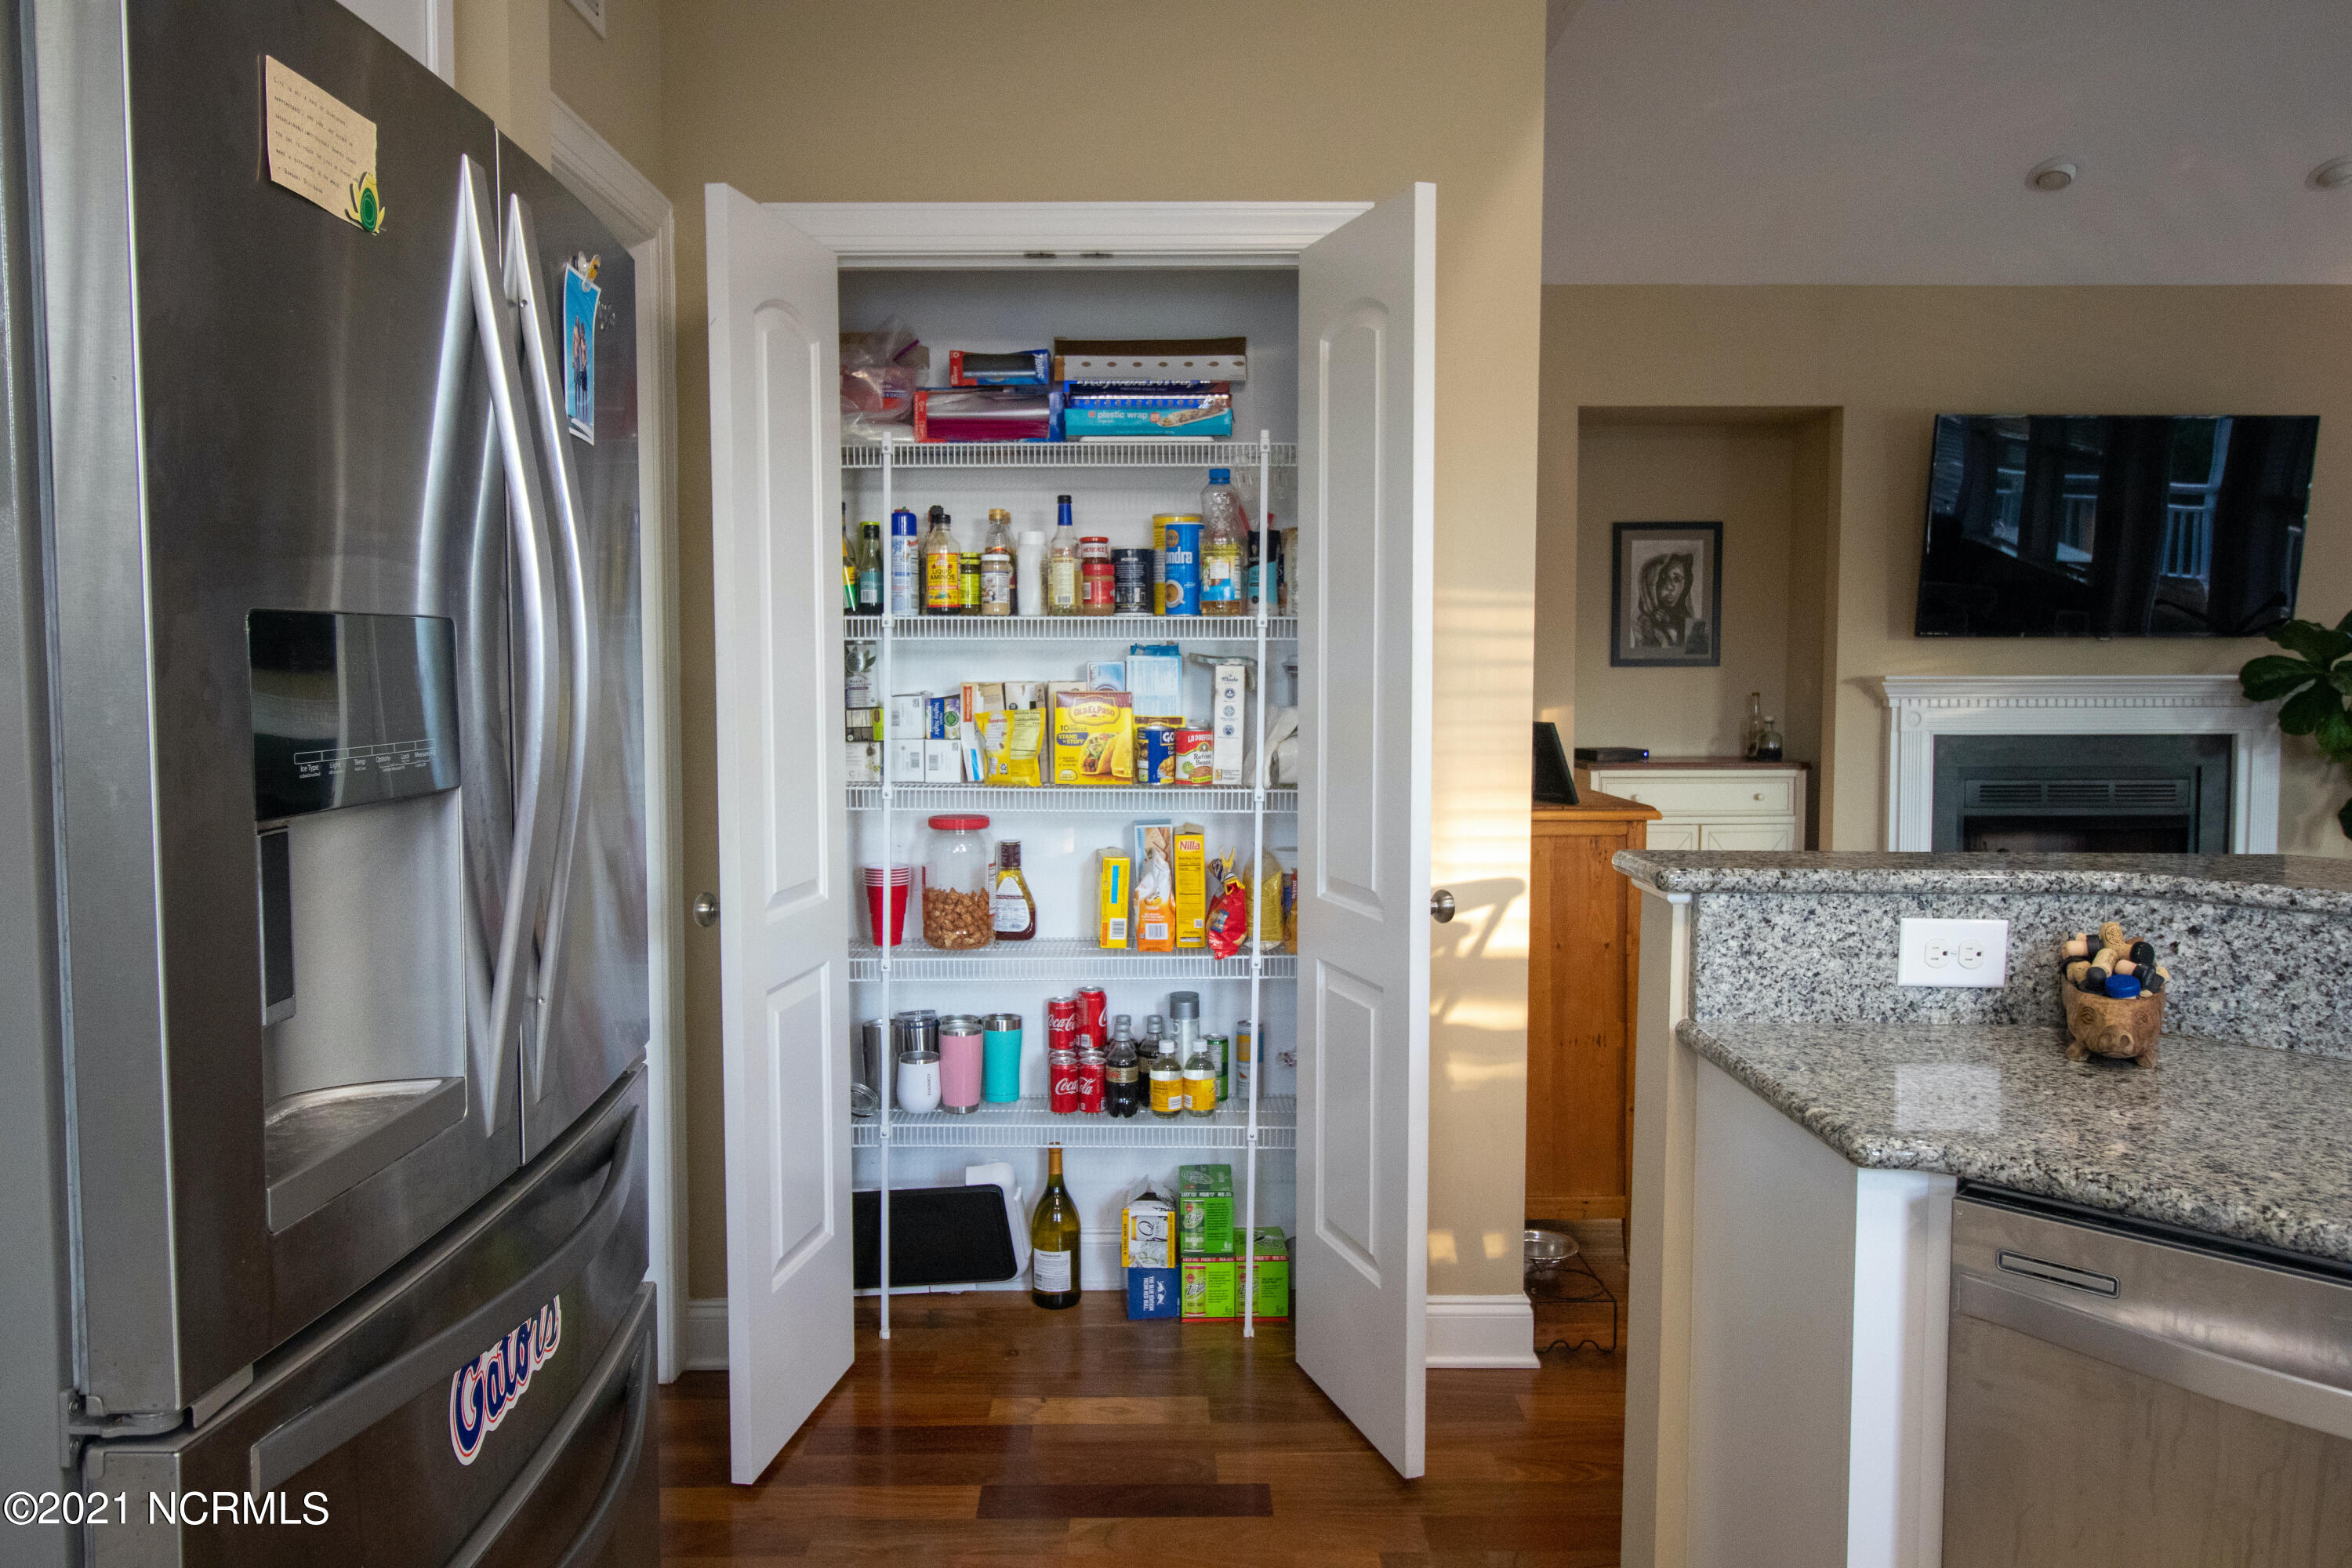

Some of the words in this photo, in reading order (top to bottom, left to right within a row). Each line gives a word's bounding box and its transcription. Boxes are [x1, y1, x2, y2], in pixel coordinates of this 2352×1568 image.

[1097, 410, 1126, 419] plastic
[1127, 412, 1148, 421] wrap
[1187, 735, 1195, 743] LA
[376, 756, 391, 764] Options
[307, 764, 320, 773] Type
[329, 761, 341, 770] Light
[1179, 840, 1200, 851] Nilla
[452, 1297, 561, 1459] Gators
